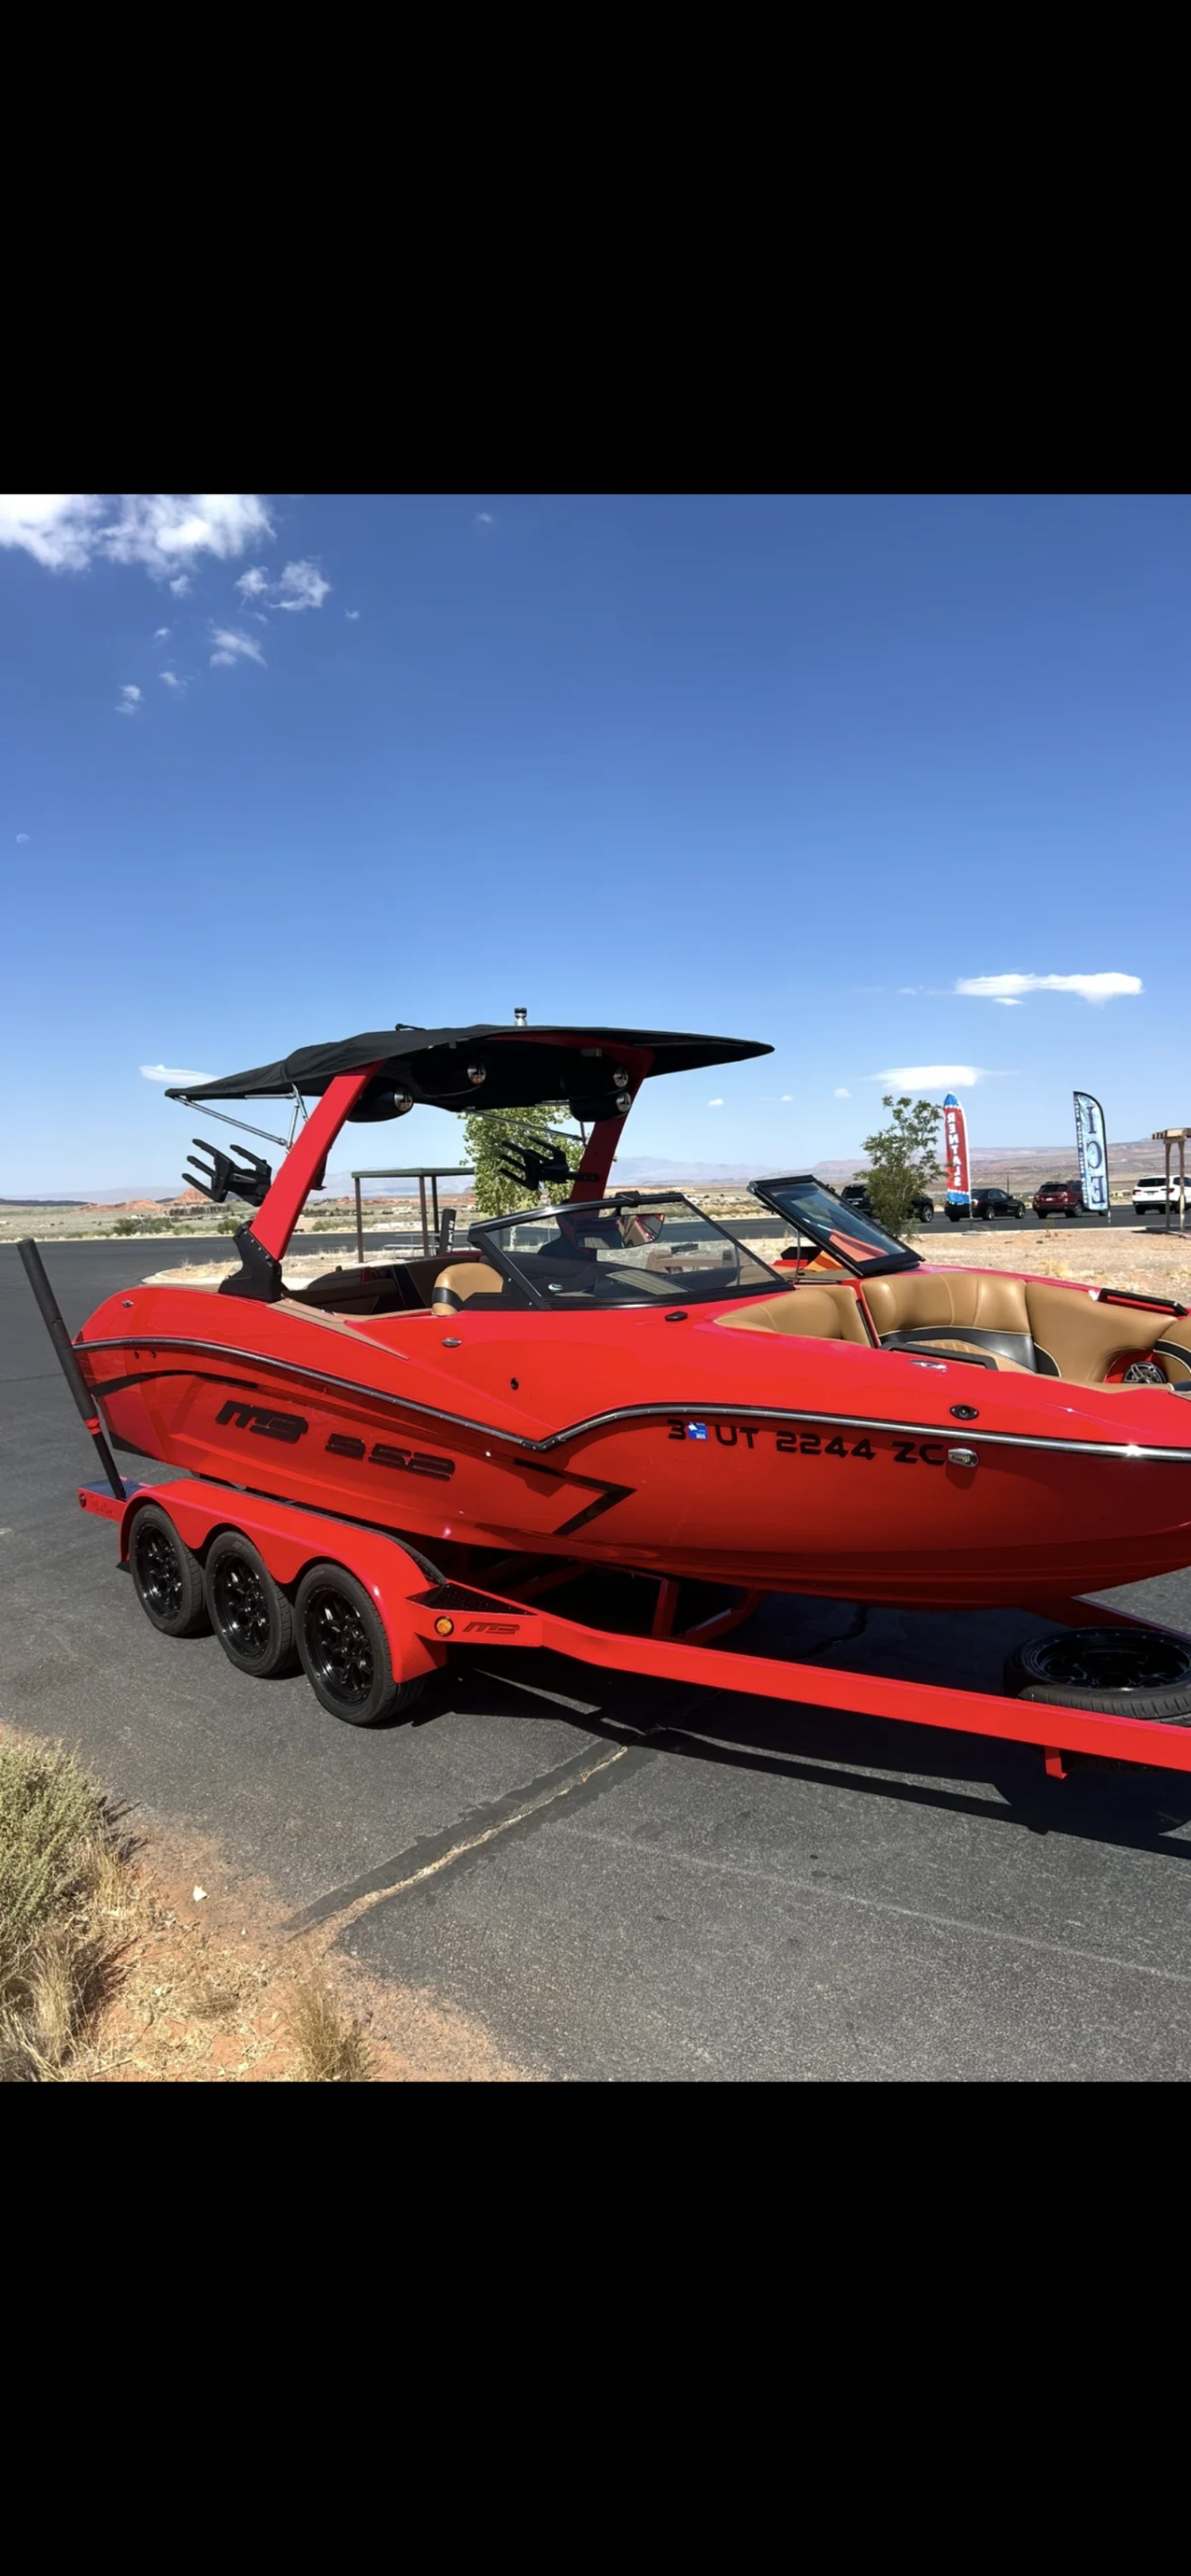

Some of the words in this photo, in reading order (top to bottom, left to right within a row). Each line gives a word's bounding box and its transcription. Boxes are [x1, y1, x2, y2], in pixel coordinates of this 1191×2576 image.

[715, 1424, 759, 1450] UT
[775, 1430, 877, 1461] 2244
[891, 1441, 946, 1466] ZC
